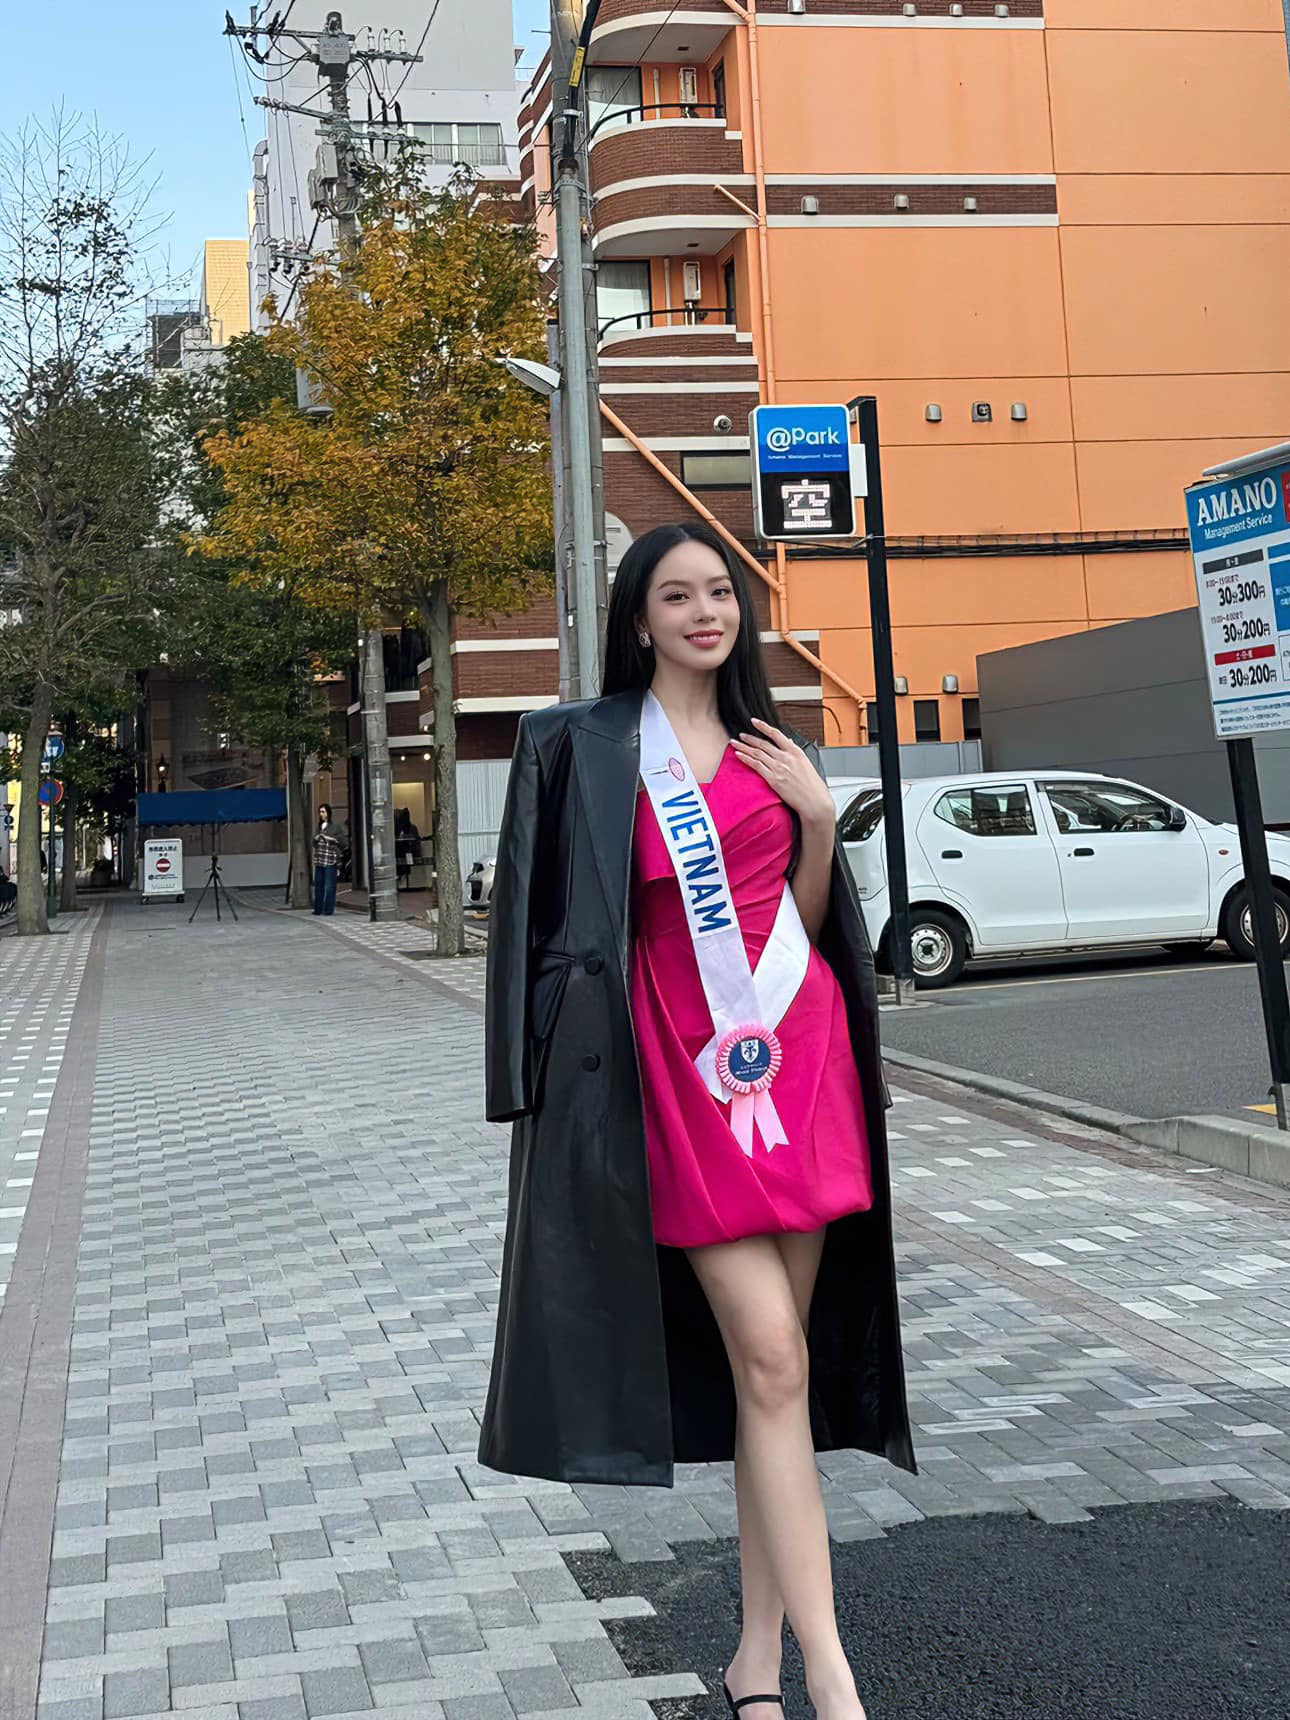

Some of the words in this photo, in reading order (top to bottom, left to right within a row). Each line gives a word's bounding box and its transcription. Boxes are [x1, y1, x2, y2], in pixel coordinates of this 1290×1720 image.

[766, 426, 840, 452] @Park
[781, 478, 833, 529] 空
[1197, 477, 1277, 527] AMANO
[1204, 519, 1246, 540] Management
[1246, 513, 1273, 529] Service
[1218, 580, 1266, 607] 30分300円
[1222, 617, 1271, 643] 30分200円
[662, 790, 732, 933] VIETNAM
